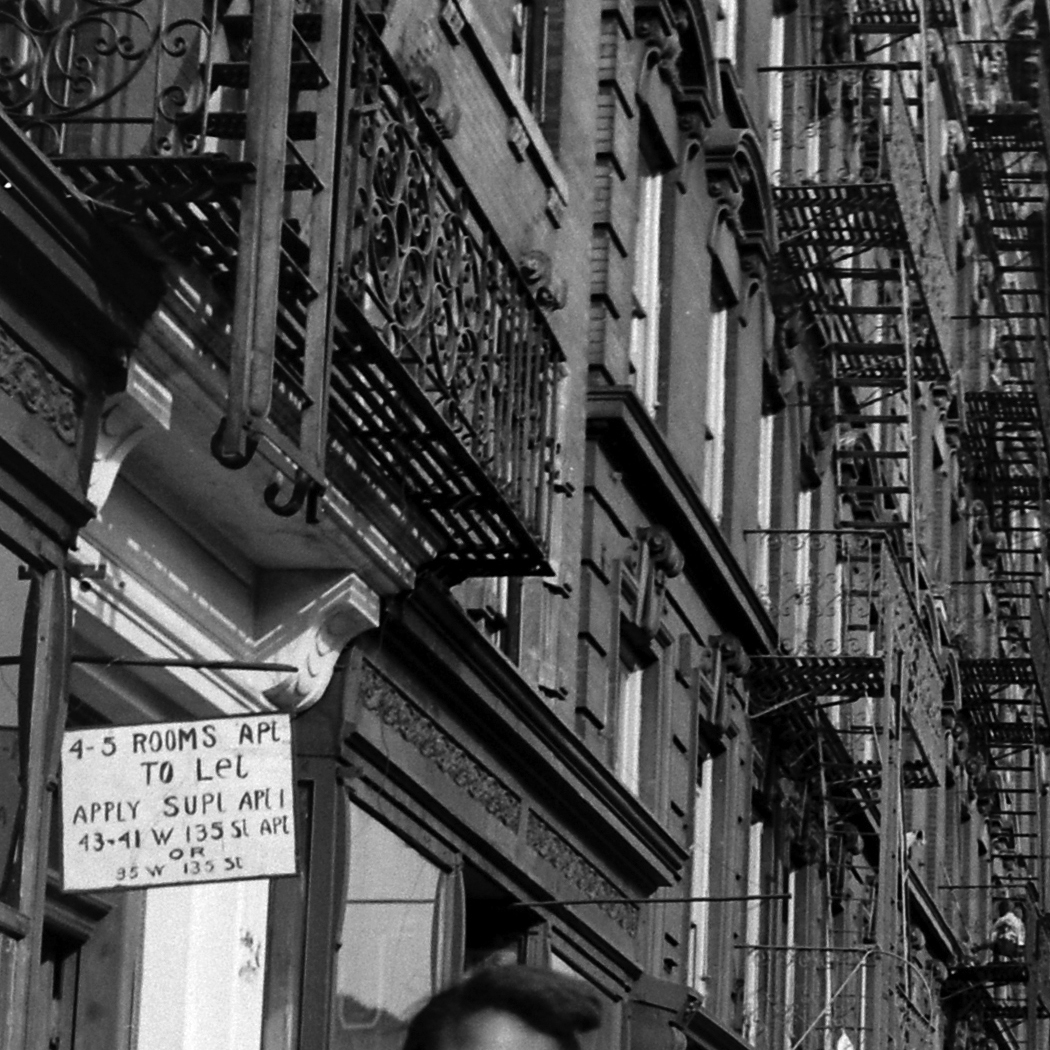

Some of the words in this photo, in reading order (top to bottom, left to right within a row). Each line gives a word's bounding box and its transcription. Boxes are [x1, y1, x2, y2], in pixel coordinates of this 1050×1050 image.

[69, 736, 117, 759] 4-5
[133, 725, 217, 754] ROOMS
[140, 761, 174, 786] TO
[73, 800, 141, 824] APPLY
[79, 830, 140, 851] 43-41
[151, 827, 174, 846] W
[186, 821, 224, 843] 135
[169, 847, 205, 860] OR
[145, 865, 165, 877] W
[183, 860, 214, 875] 135
